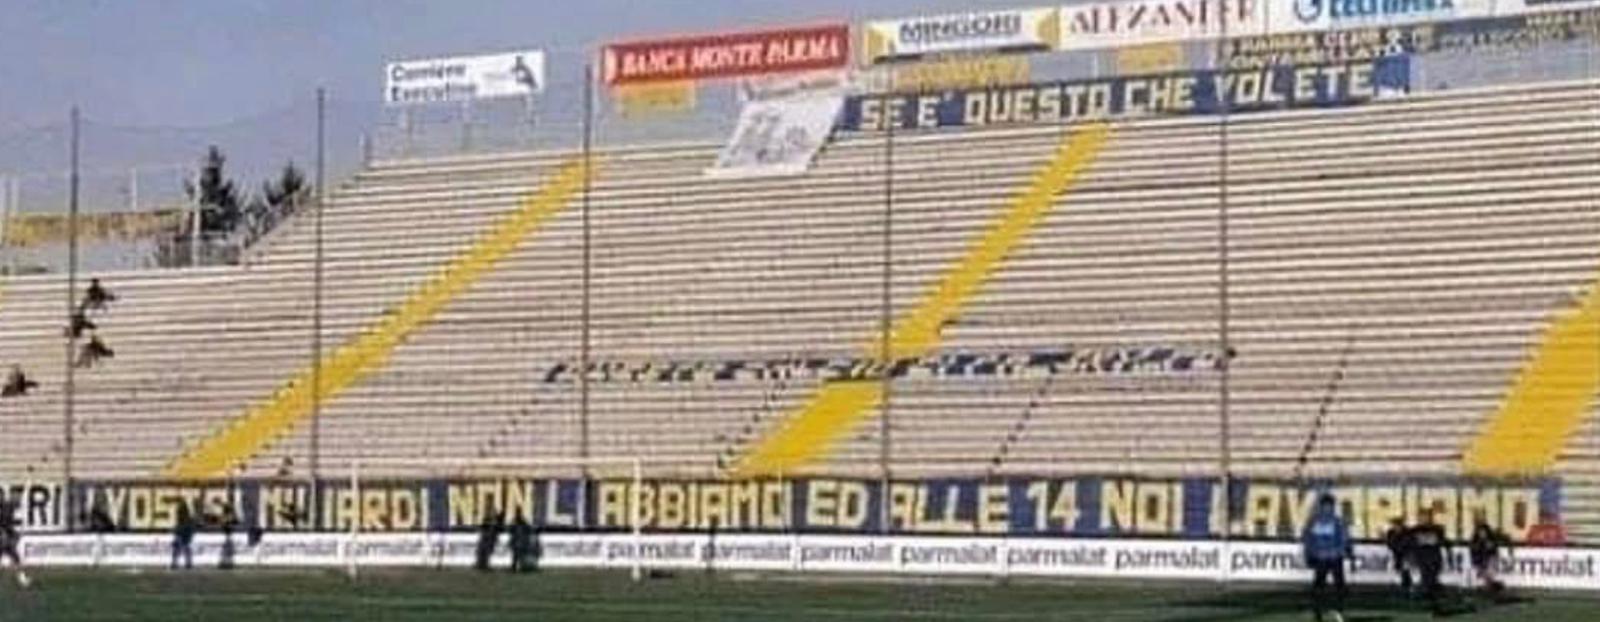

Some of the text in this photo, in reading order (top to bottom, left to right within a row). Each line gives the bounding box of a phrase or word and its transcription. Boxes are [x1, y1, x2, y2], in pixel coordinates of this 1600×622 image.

[621, 50, 687, 77] BANCA
[691, 42, 765, 71] MONTE
[859, 97, 907, 131] SE
[964, 83, 1112, 126] QUESTO
[1124, 76, 1198, 115] CHE
[1212, 63, 1375, 106] VOLETE
[448, 482, 535, 527] NON
[598, 481, 794, 529] ABBIAMO
[806, 480, 868, 528] ED
[889, 482, 1010, 532] ALLE
[1026, 480, 1081, 532] 14
[1101, 480, 1185, 533] NOI
[901, 544, 996, 569] parmalat
[1007, 545, 1109, 567] parmalat
[1115, 546, 1221, 571] parmalat
